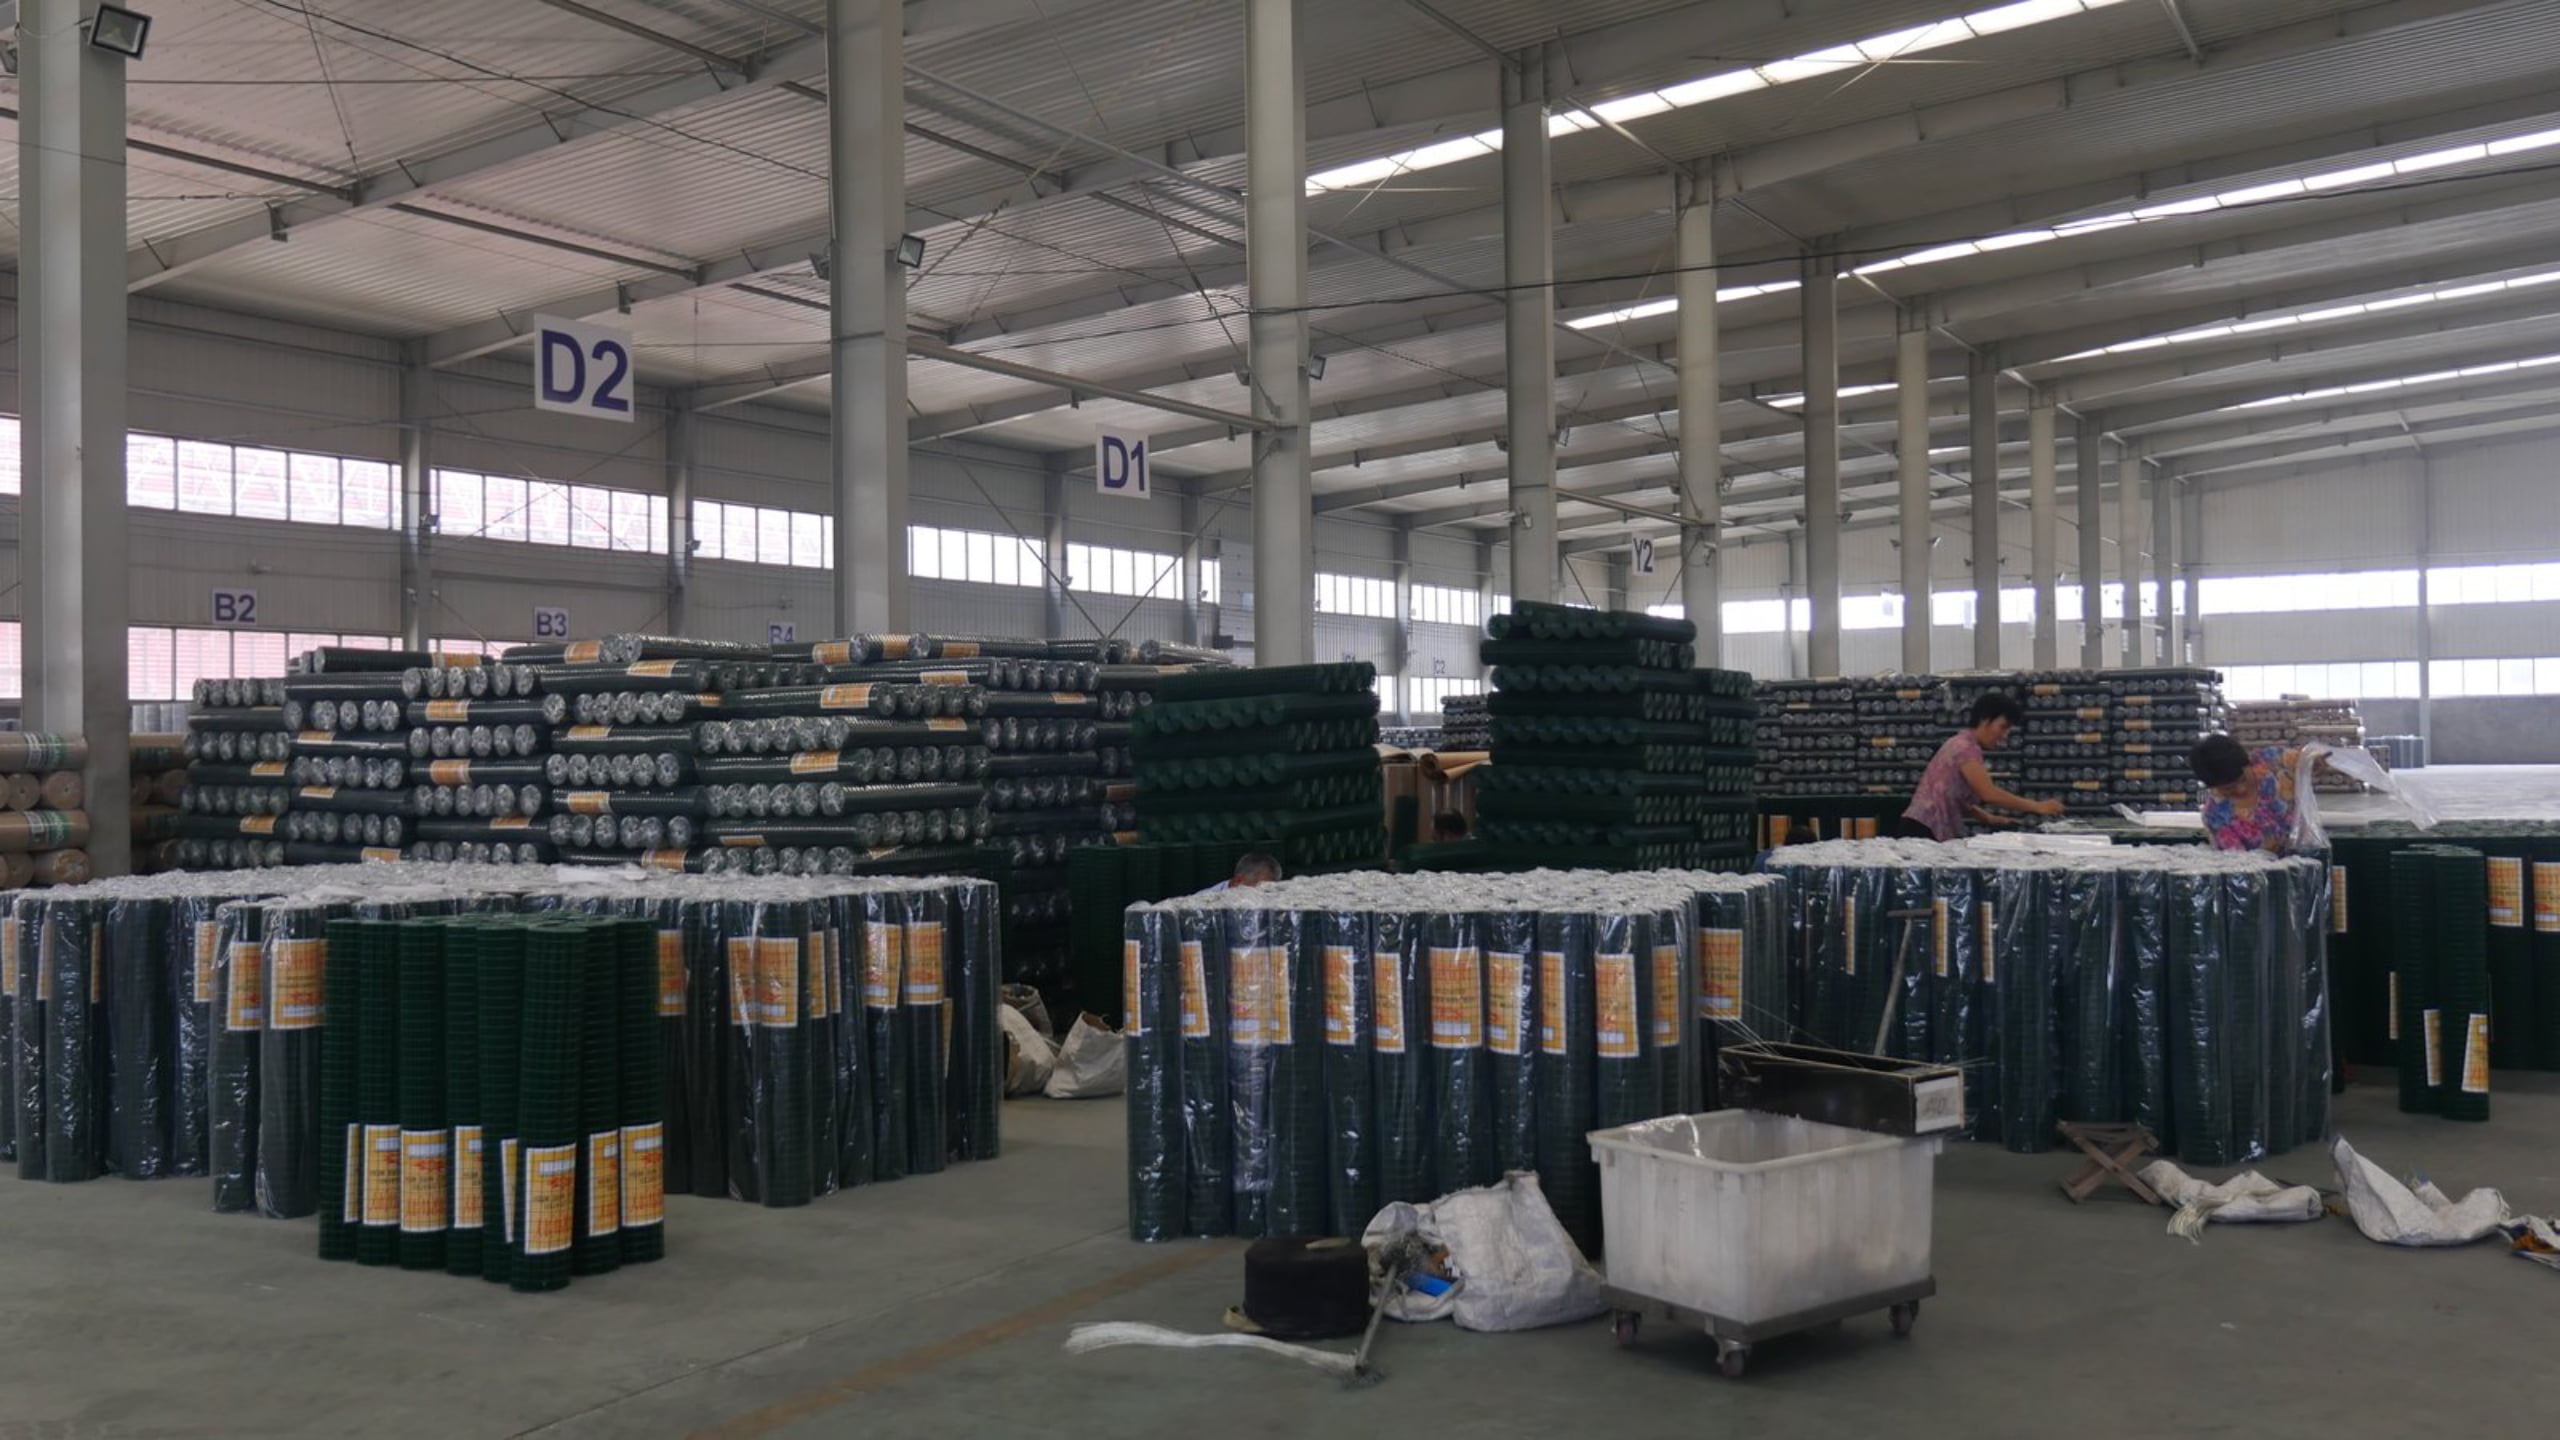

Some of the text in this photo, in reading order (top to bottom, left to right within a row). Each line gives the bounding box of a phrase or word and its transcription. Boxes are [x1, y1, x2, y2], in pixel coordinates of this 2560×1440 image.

[541, 329, 629, 412] D2
[1102, 434, 1145, 492] D1
[1633, 537, 1654, 573] Y2
[214, 592, 256, 624] B2
[536, 611, 567, 637] B3
[769, 624, 794, 643] B4
